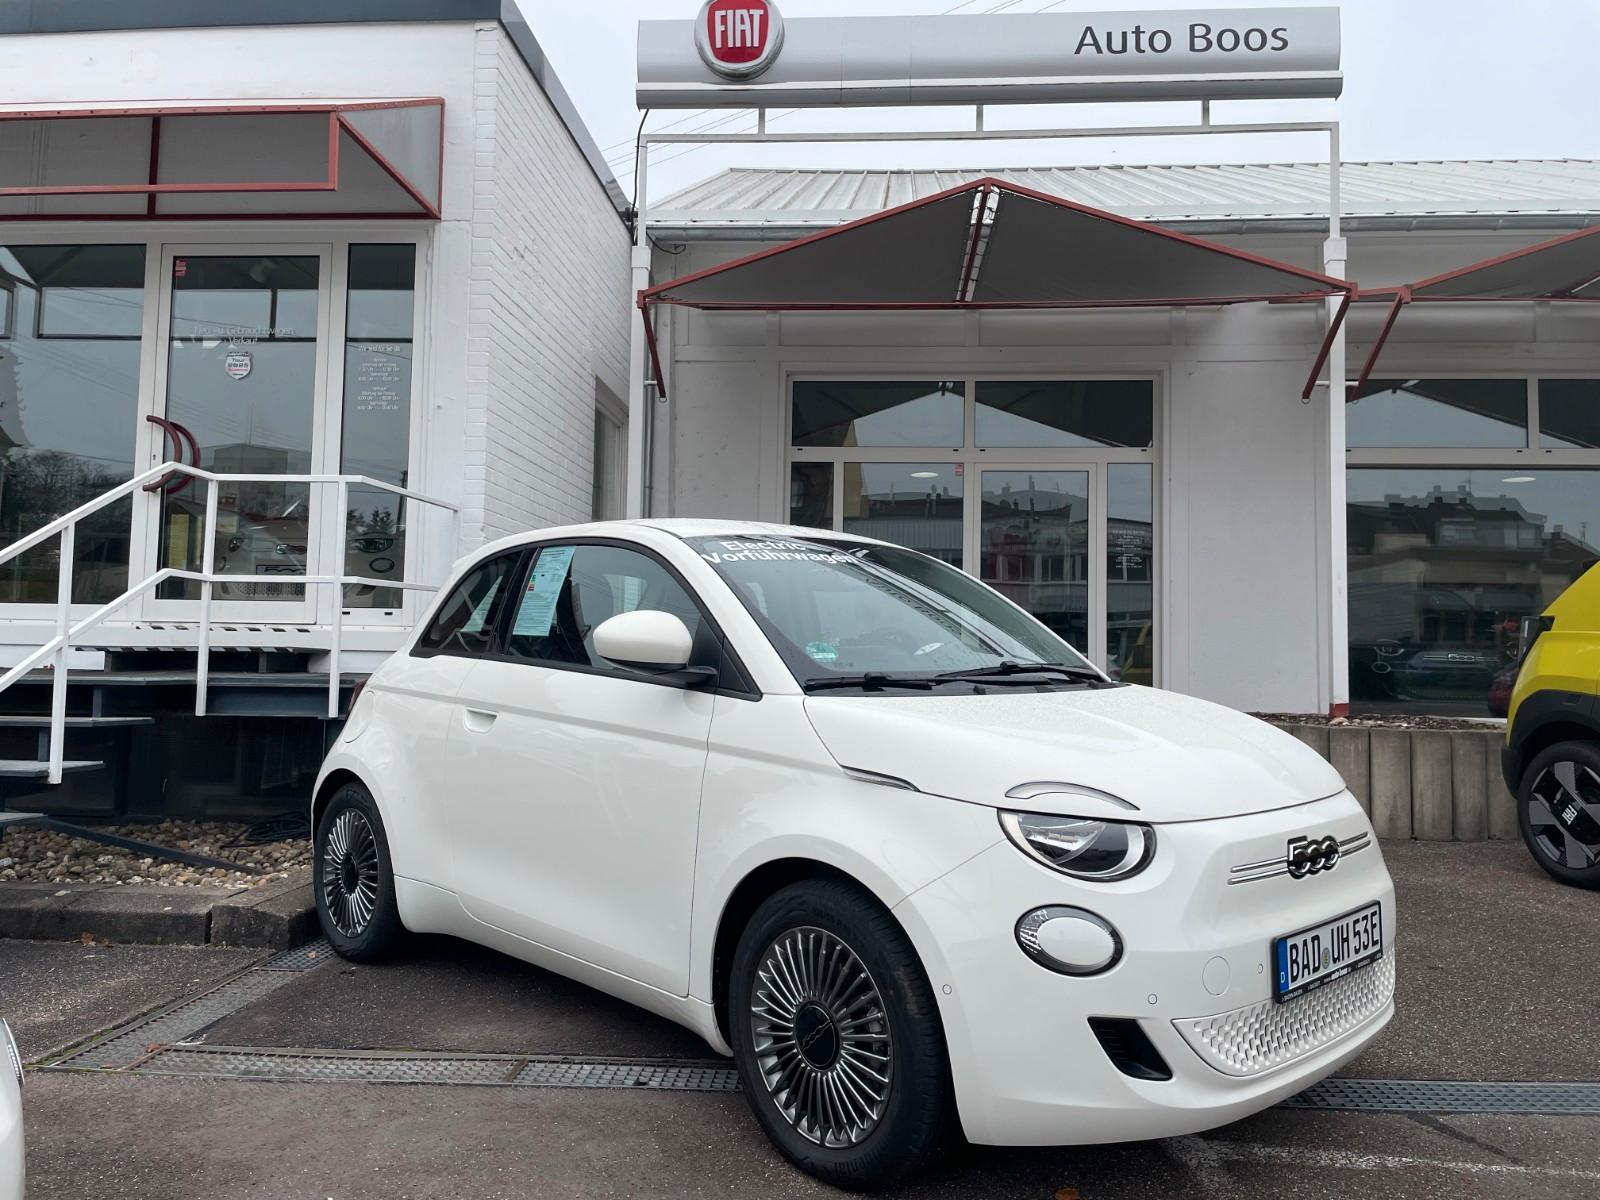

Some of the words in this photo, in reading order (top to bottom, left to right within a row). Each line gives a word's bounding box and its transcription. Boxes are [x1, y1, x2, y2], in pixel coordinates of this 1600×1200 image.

[714, 9, 764, 48] FIAT
[1074, 25, 1172, 55] Auto
[1189, 23, 1289, 53] Boos
[701, 549, 859, 564] Vorführwagen
[720, 540, 806, 551] Electric
[1287, 835, 1340, 879] 500
[1280, 971, 1286, 983] D
[1289, 934, 1321, 984] BAD
[1331, 922, 1350, 965] UH
[1352, 910, 1380, 955] 53E
